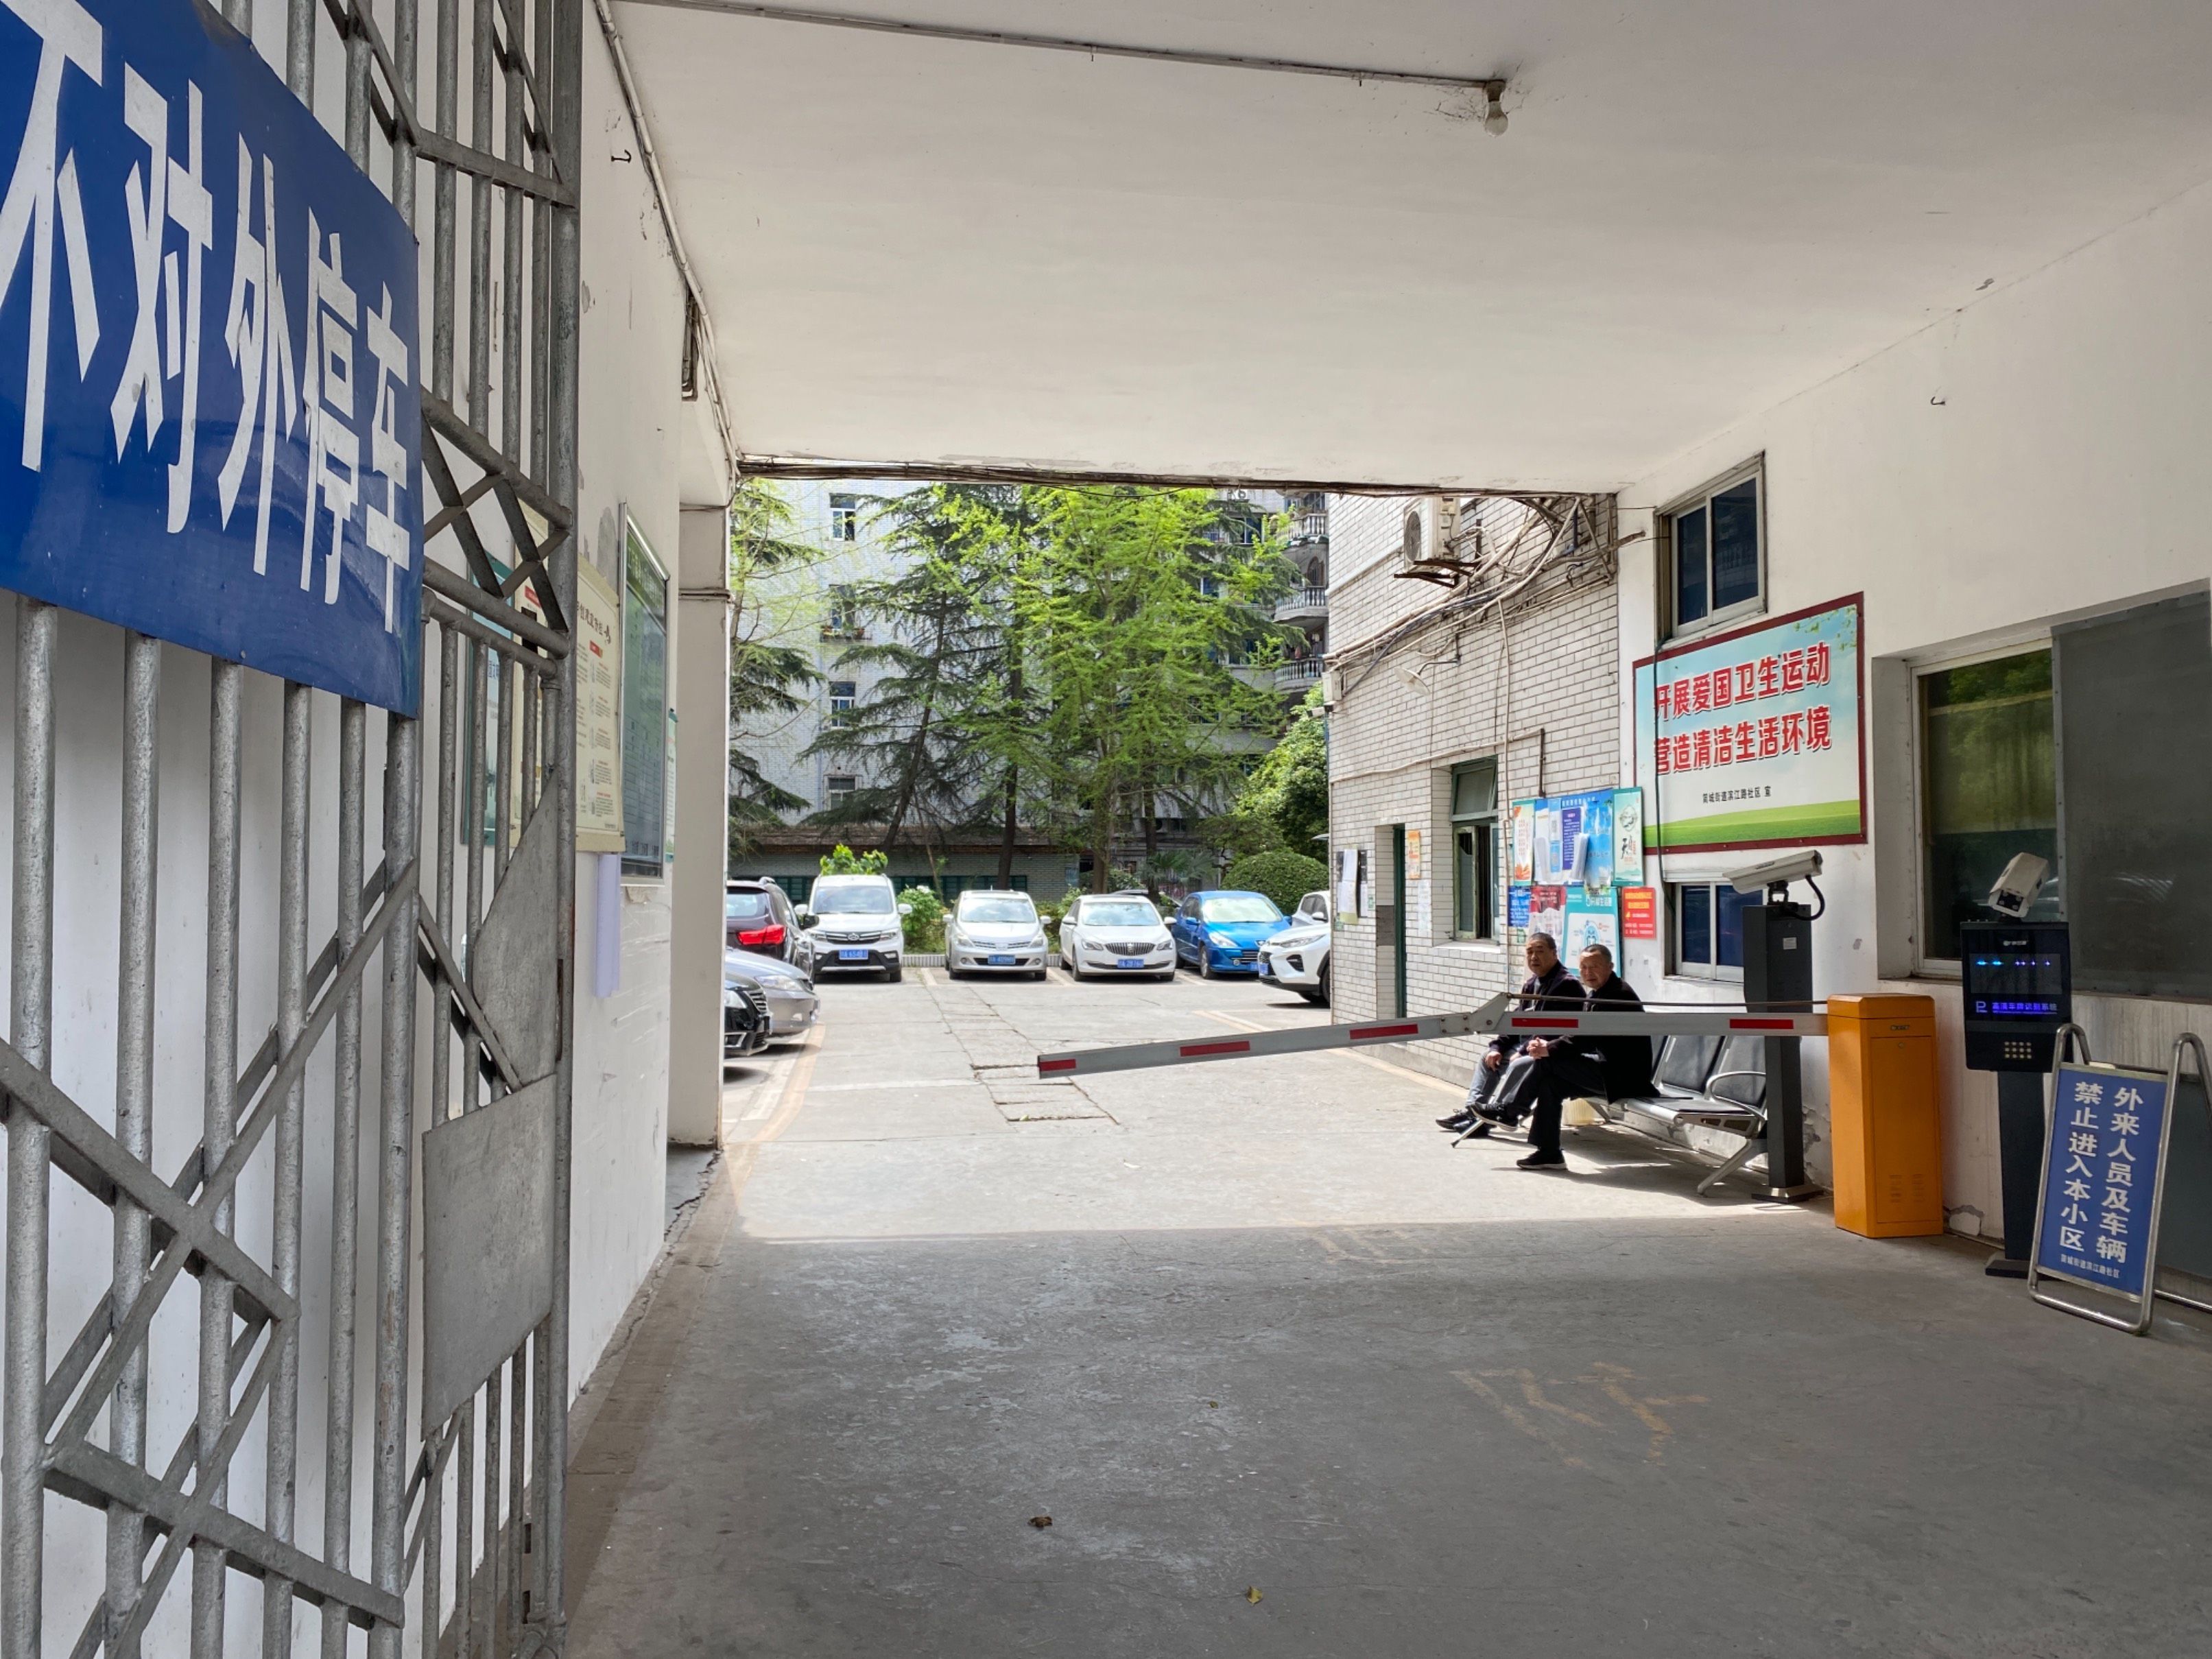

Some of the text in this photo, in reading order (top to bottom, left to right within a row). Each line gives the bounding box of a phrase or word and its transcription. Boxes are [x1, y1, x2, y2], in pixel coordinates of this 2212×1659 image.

[0, 0, 410, 634] 不对外停车
[1654, 641, 1831, 724] 开展爱国卫生运动
[1654, 705, 1832, 776] 营造清洁生活环境
[2060, 1081, 2103, 1252] 禁止进入本小区
[2096, 1087, 2143, 1263] 外来人员及车辆
